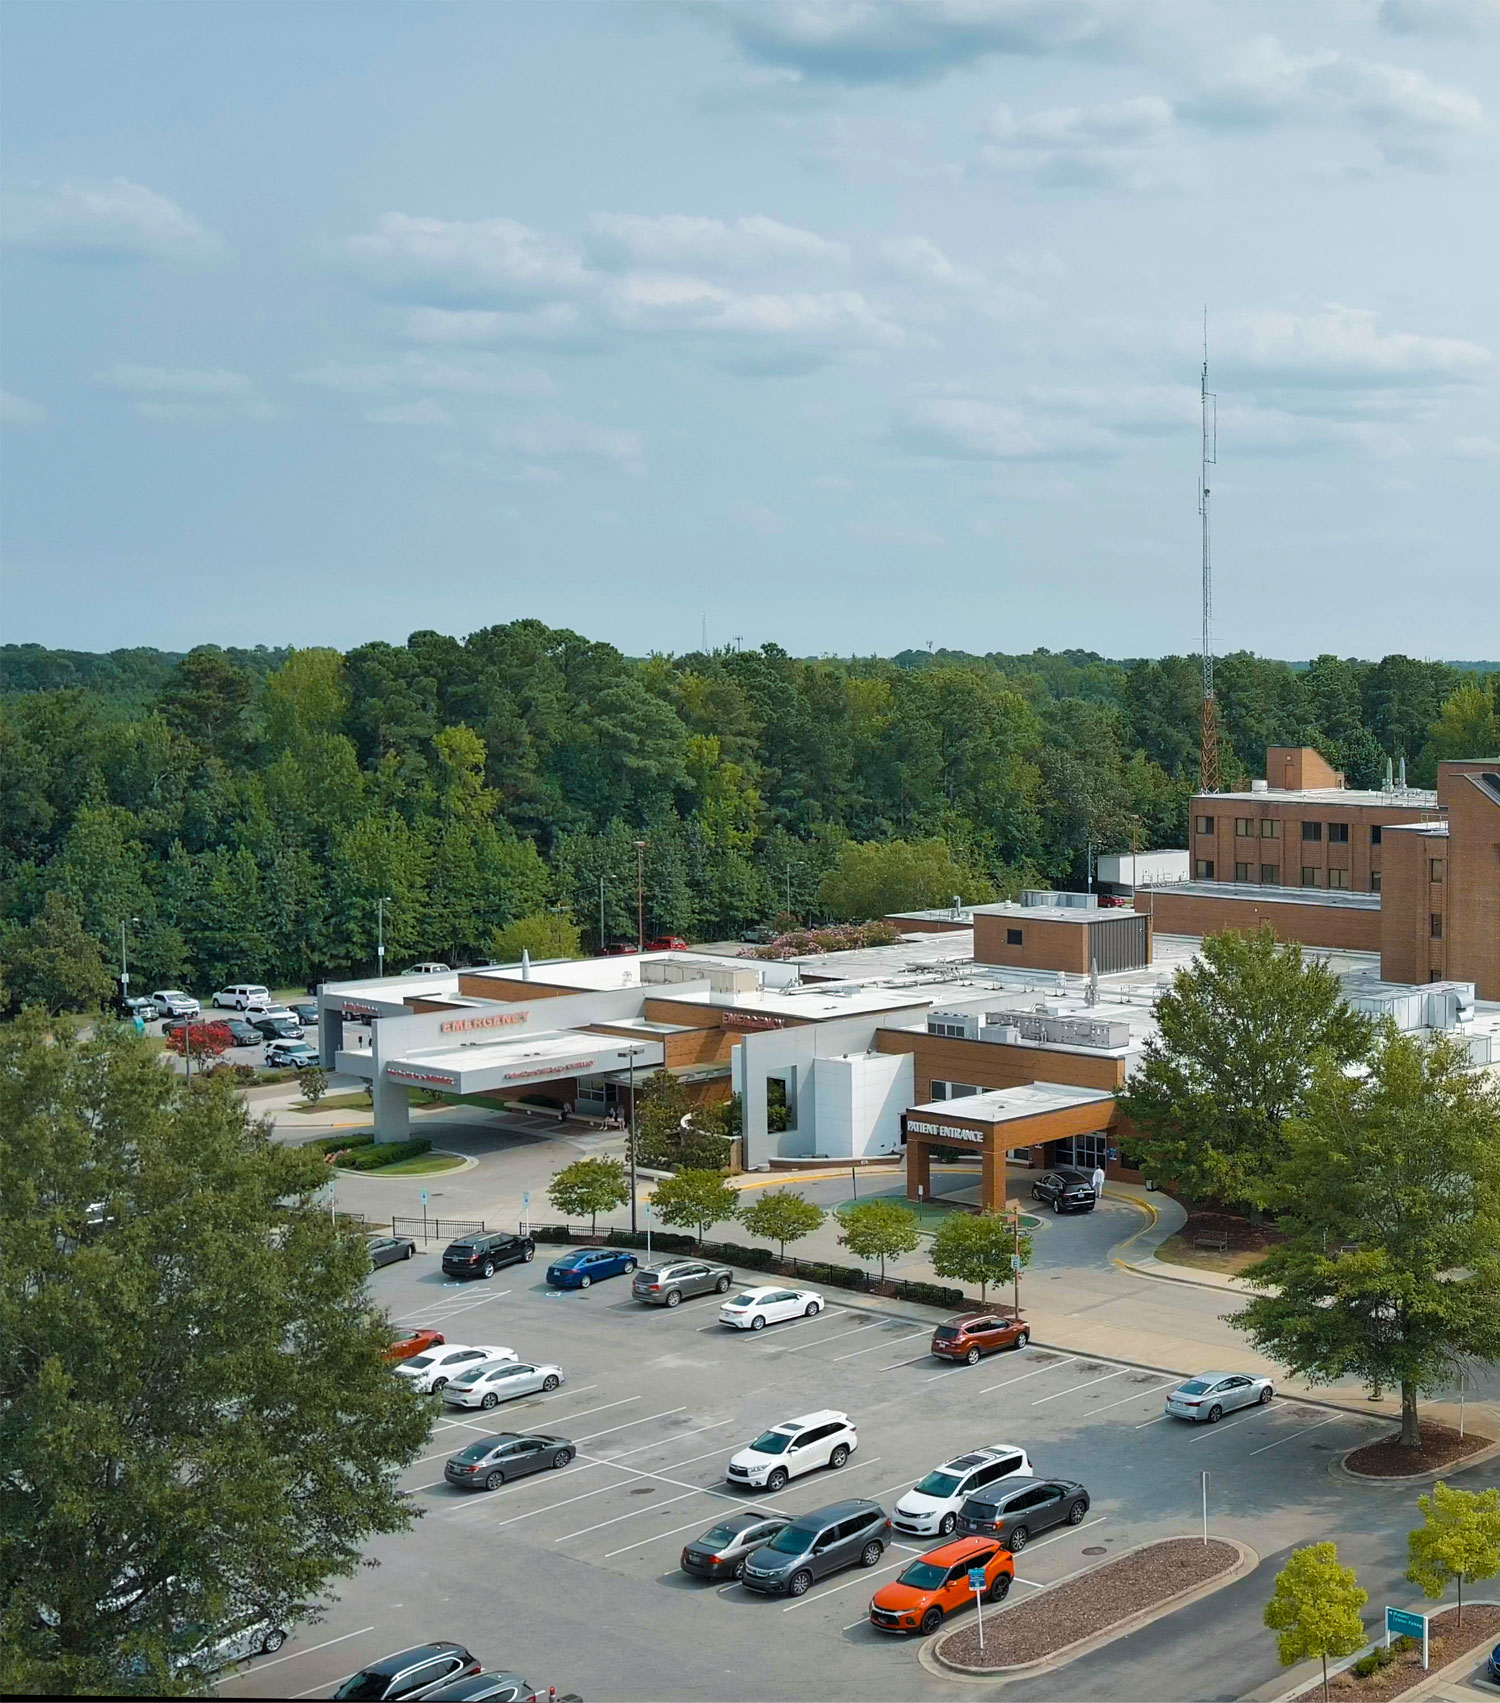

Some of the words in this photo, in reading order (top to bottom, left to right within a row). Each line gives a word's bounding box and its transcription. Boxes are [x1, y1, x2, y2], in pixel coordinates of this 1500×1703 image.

[440, 1010, 530, 1033] EMERGENCY
[722, 1011, 785, 1029] EMERGENCY
[907, 1120, 939, 1135] PATIENT
[940, 1125, 984, 1143] ENTRANCE
